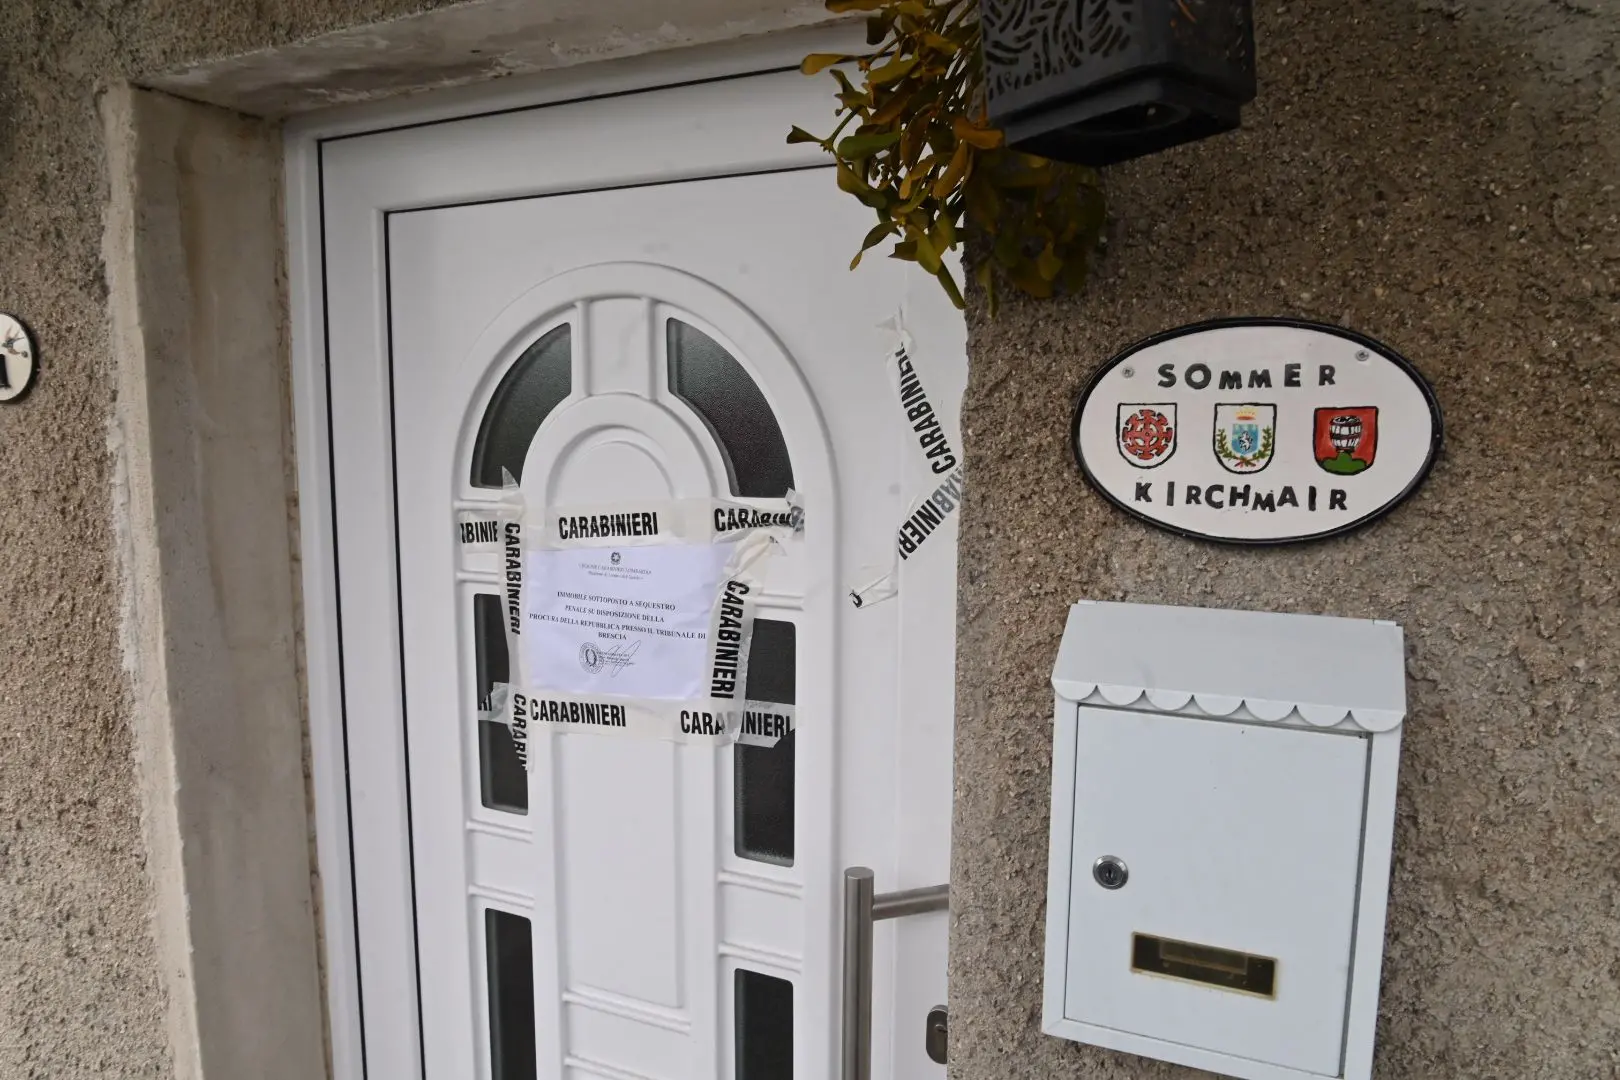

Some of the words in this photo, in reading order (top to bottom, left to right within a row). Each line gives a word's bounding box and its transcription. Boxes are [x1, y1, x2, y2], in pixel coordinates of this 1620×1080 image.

[1157, 362, 1336, 390] SOMMER
[1134, 481, 1348, 513] KIRCHMAIR
[558, 512, 659, 540] CARABINIERI
[504, 522, 522, 636] CARABINIERI
[557, 591, 587, 601] IMMOBILE
[588, 594, 628, 605] SOTTOPOSTO
[635, 599, 676, 611] SEQUESTRO
[565, 604, 587, 614] PENALE
[596, 609, 640, 620] DISPOSIZIONE
[642, 614, 664, 623] DELLA
[560, 617, 579, 625] DELLA
[580, 620, 620, 630] REPUBBLICA
[621, 624, 647, 633] PRESSO
[656, 628, 696, 639] TRIBUNALE
[697, 632, 706, 640] DI
[598, 631, 627, 640] BRESCIA
[711, 580, 750, 700] CARABINIERI
[530, 698, 627, 728] CARABINIERI
